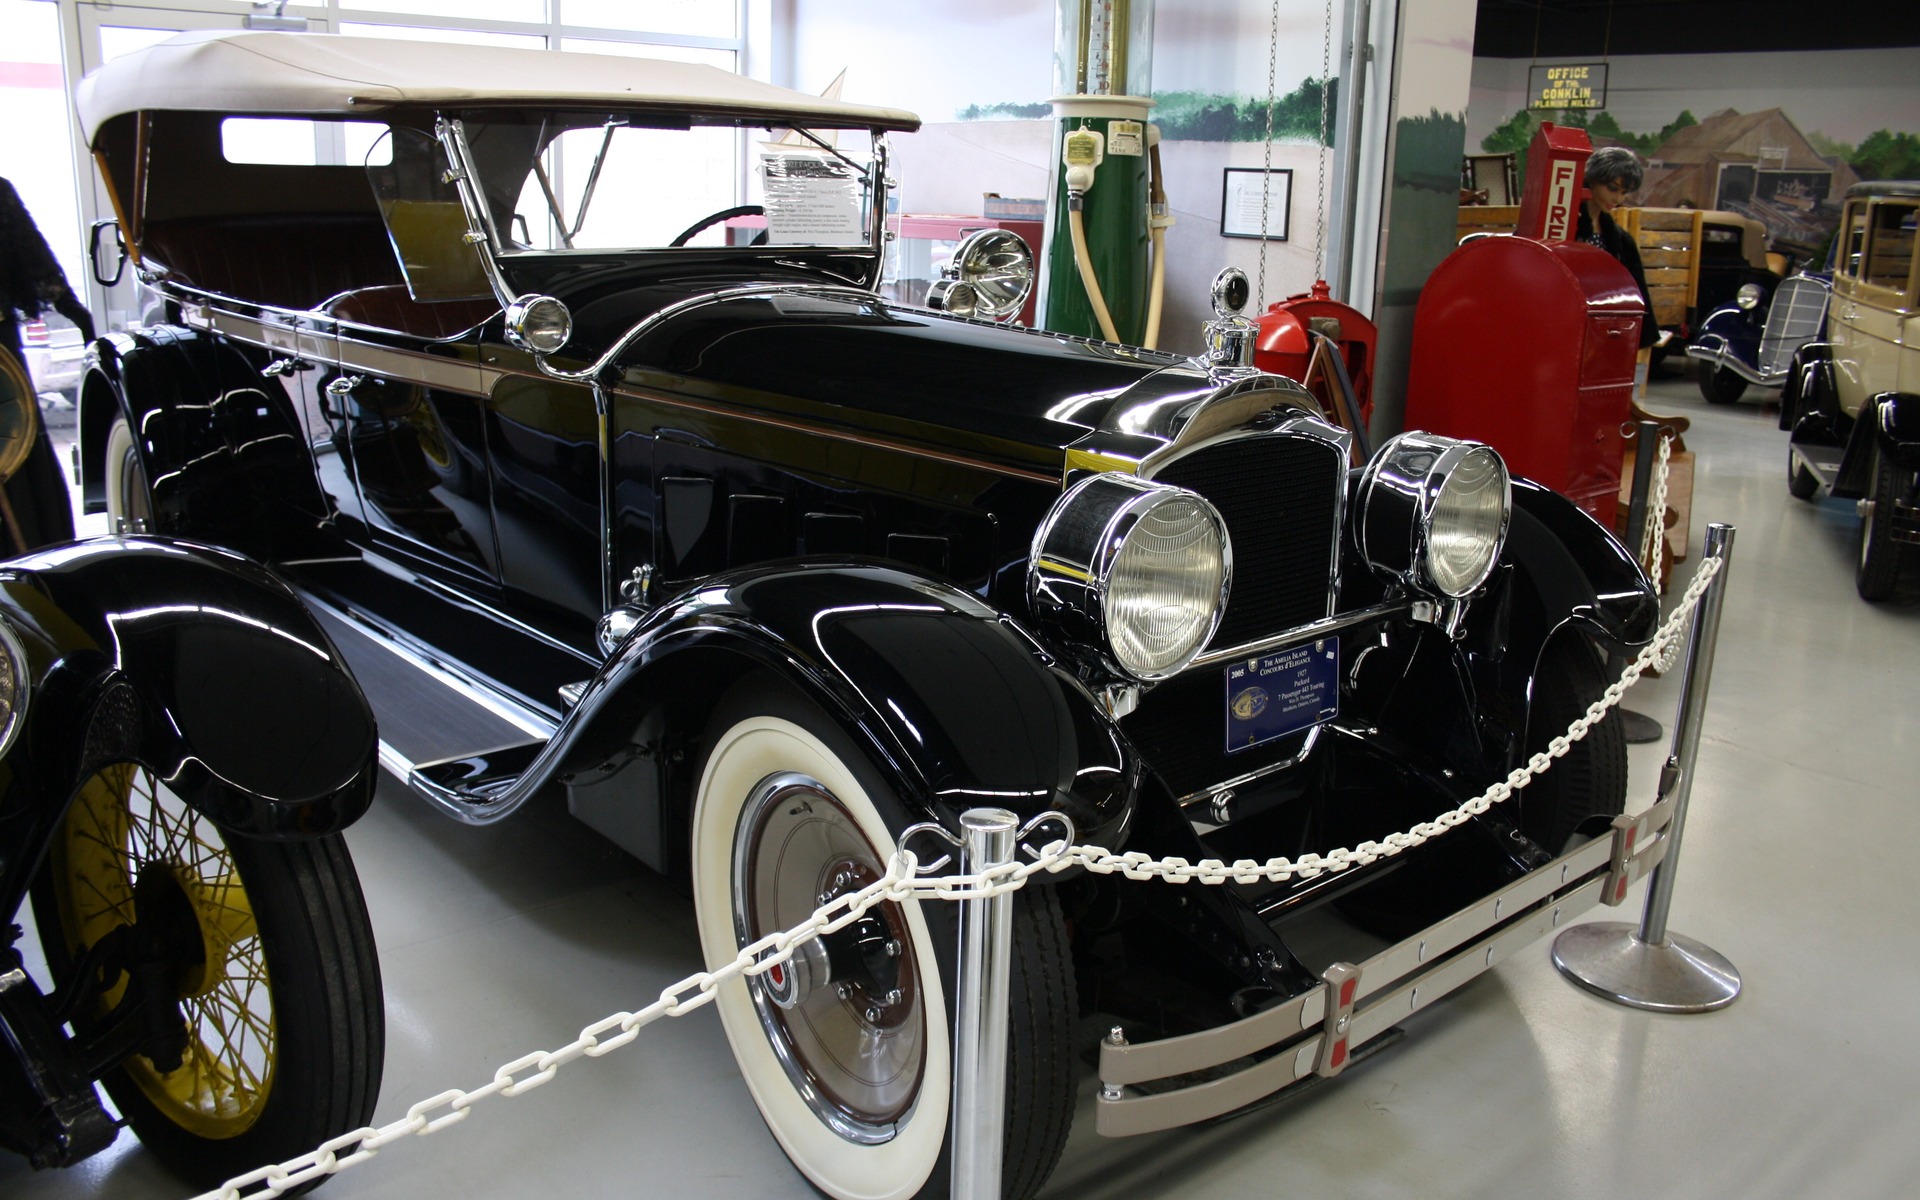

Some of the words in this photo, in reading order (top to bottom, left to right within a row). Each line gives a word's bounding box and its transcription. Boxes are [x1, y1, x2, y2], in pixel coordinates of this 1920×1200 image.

[1547, 67, 1589, 80] OFFICE
[1098, 81, 1109, 90] 10
[1553, 80, 1564, 88] OF
[1565, 80, 1579, 88] THE
[1542, 87, 1591, 99] CONKLIN
[1534, 99, 1569, 108] PLANING
[1570, 99, 1597, 107] MILLS
[1547, 167, 1573, 240] FIRE
[1291, 650, 1308, 660] ISLAND
[1231, 668, 1245, 679] 2005
[1260, 663, 1284, 677] CONCOURS
[1294, 677, 1310, 688] Packard
[1281, 689, 1301, 700] Passenger
[1309, 681, 1325, 692] Touring
